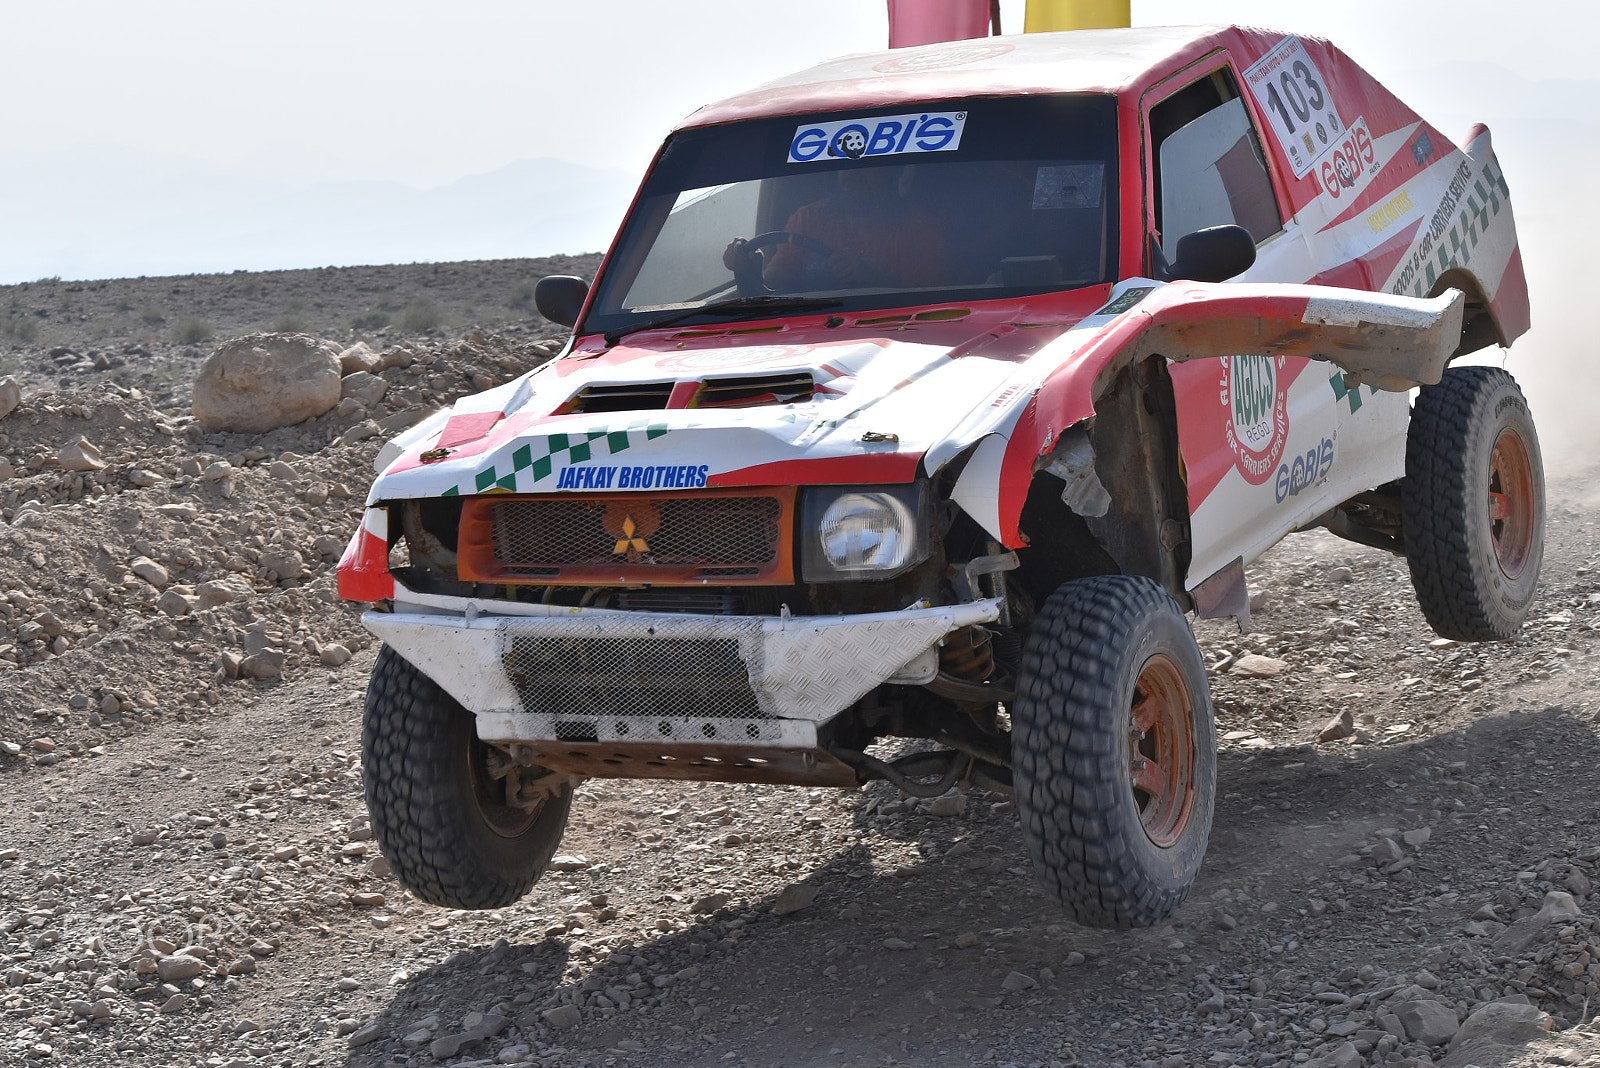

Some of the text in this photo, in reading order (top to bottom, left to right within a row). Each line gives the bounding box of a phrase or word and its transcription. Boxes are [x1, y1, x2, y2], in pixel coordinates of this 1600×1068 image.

[1249, 64, 1271, 85] PAKISTAN
[1266, 60, 1324, 135] 103
[1413, 251, 1420, 271] &
[1419, 231, 1433, 260] CAR
[1430, 191, 1456, 241] CARRIERS
[1449, 159, 1472, 202] SERVICE
[1226, 391, 1285, 476] CAR CARRIERS SERVICES
[556, 464, 709, 489] JAFKAY BROTHERS
